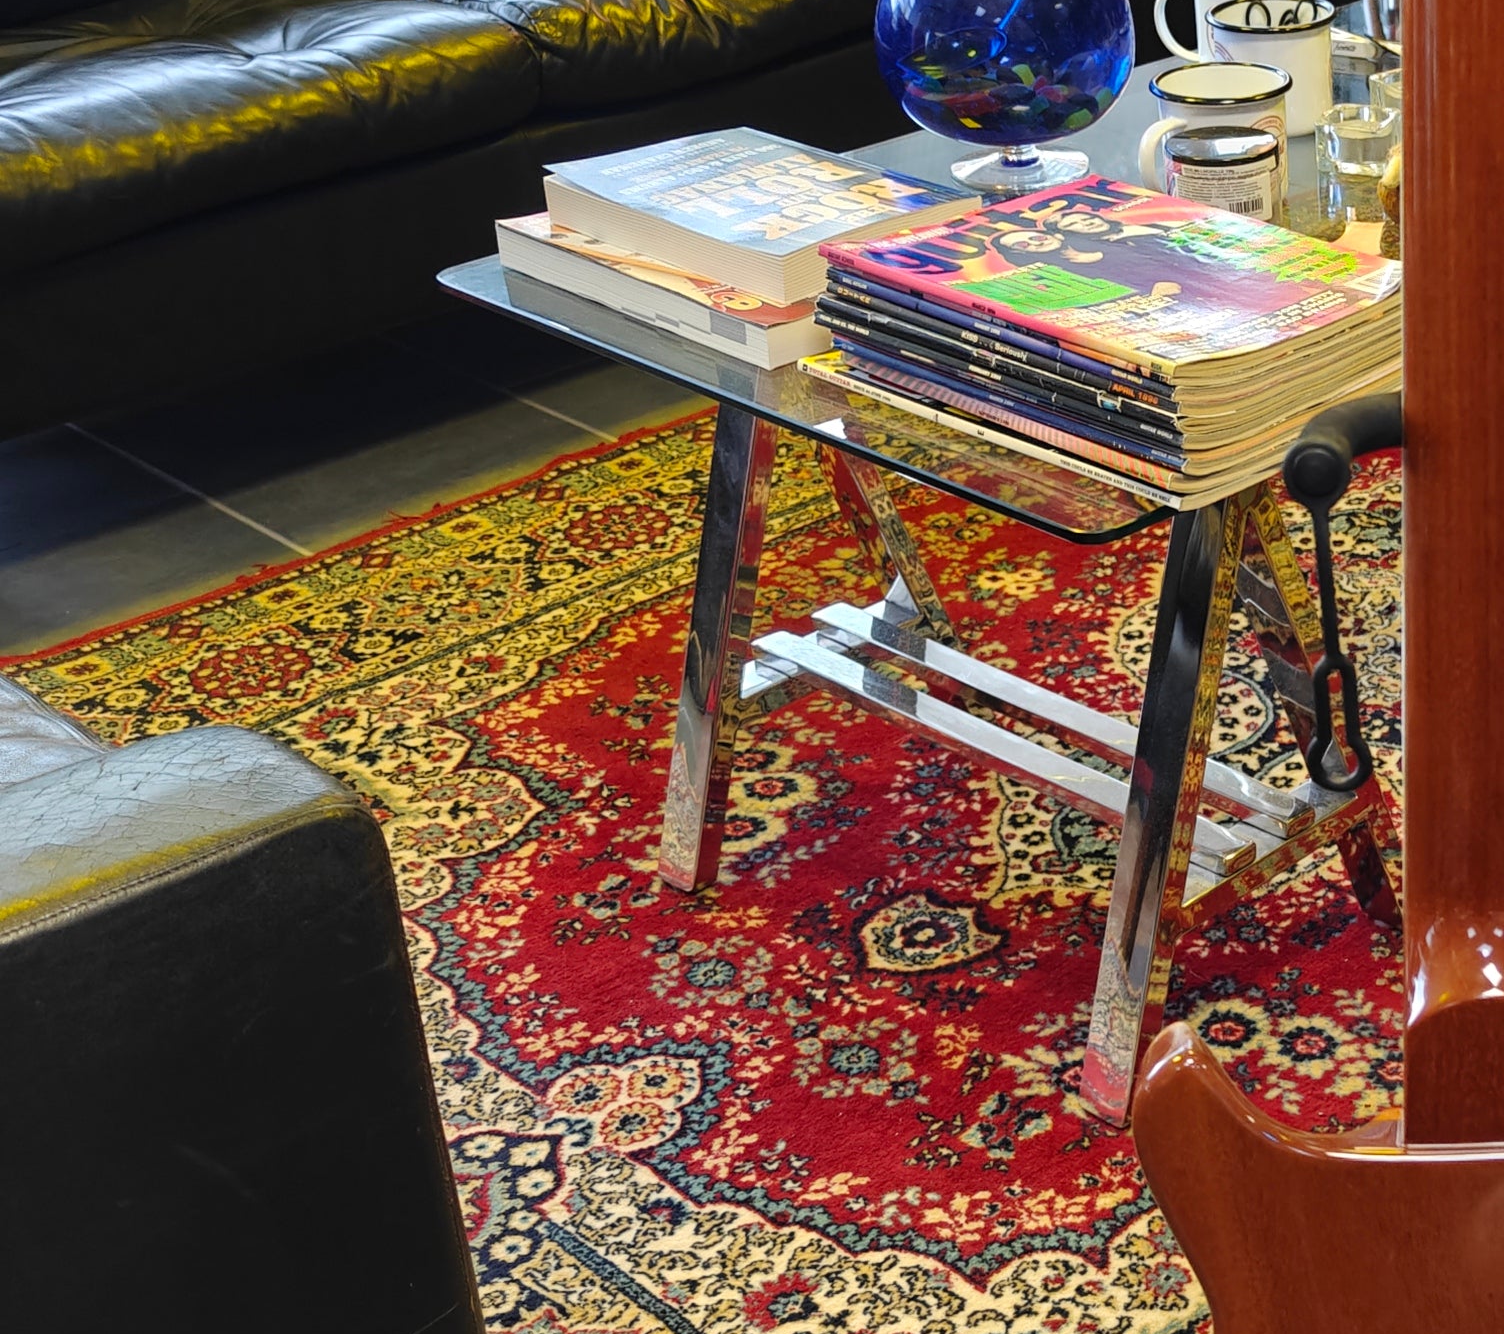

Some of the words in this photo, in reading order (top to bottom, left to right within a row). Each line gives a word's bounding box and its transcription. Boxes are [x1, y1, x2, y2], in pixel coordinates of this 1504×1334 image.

[677, 160, 866, 218] ROLL
[732, 171, 926, 240] ROCK
[858, 176, 1146, 275] guitar
[807, 367, 829, 378] TOTAL
[827, 374, 852, 387] GUITAR
[1110, 382, 1136, 398] APRIL
